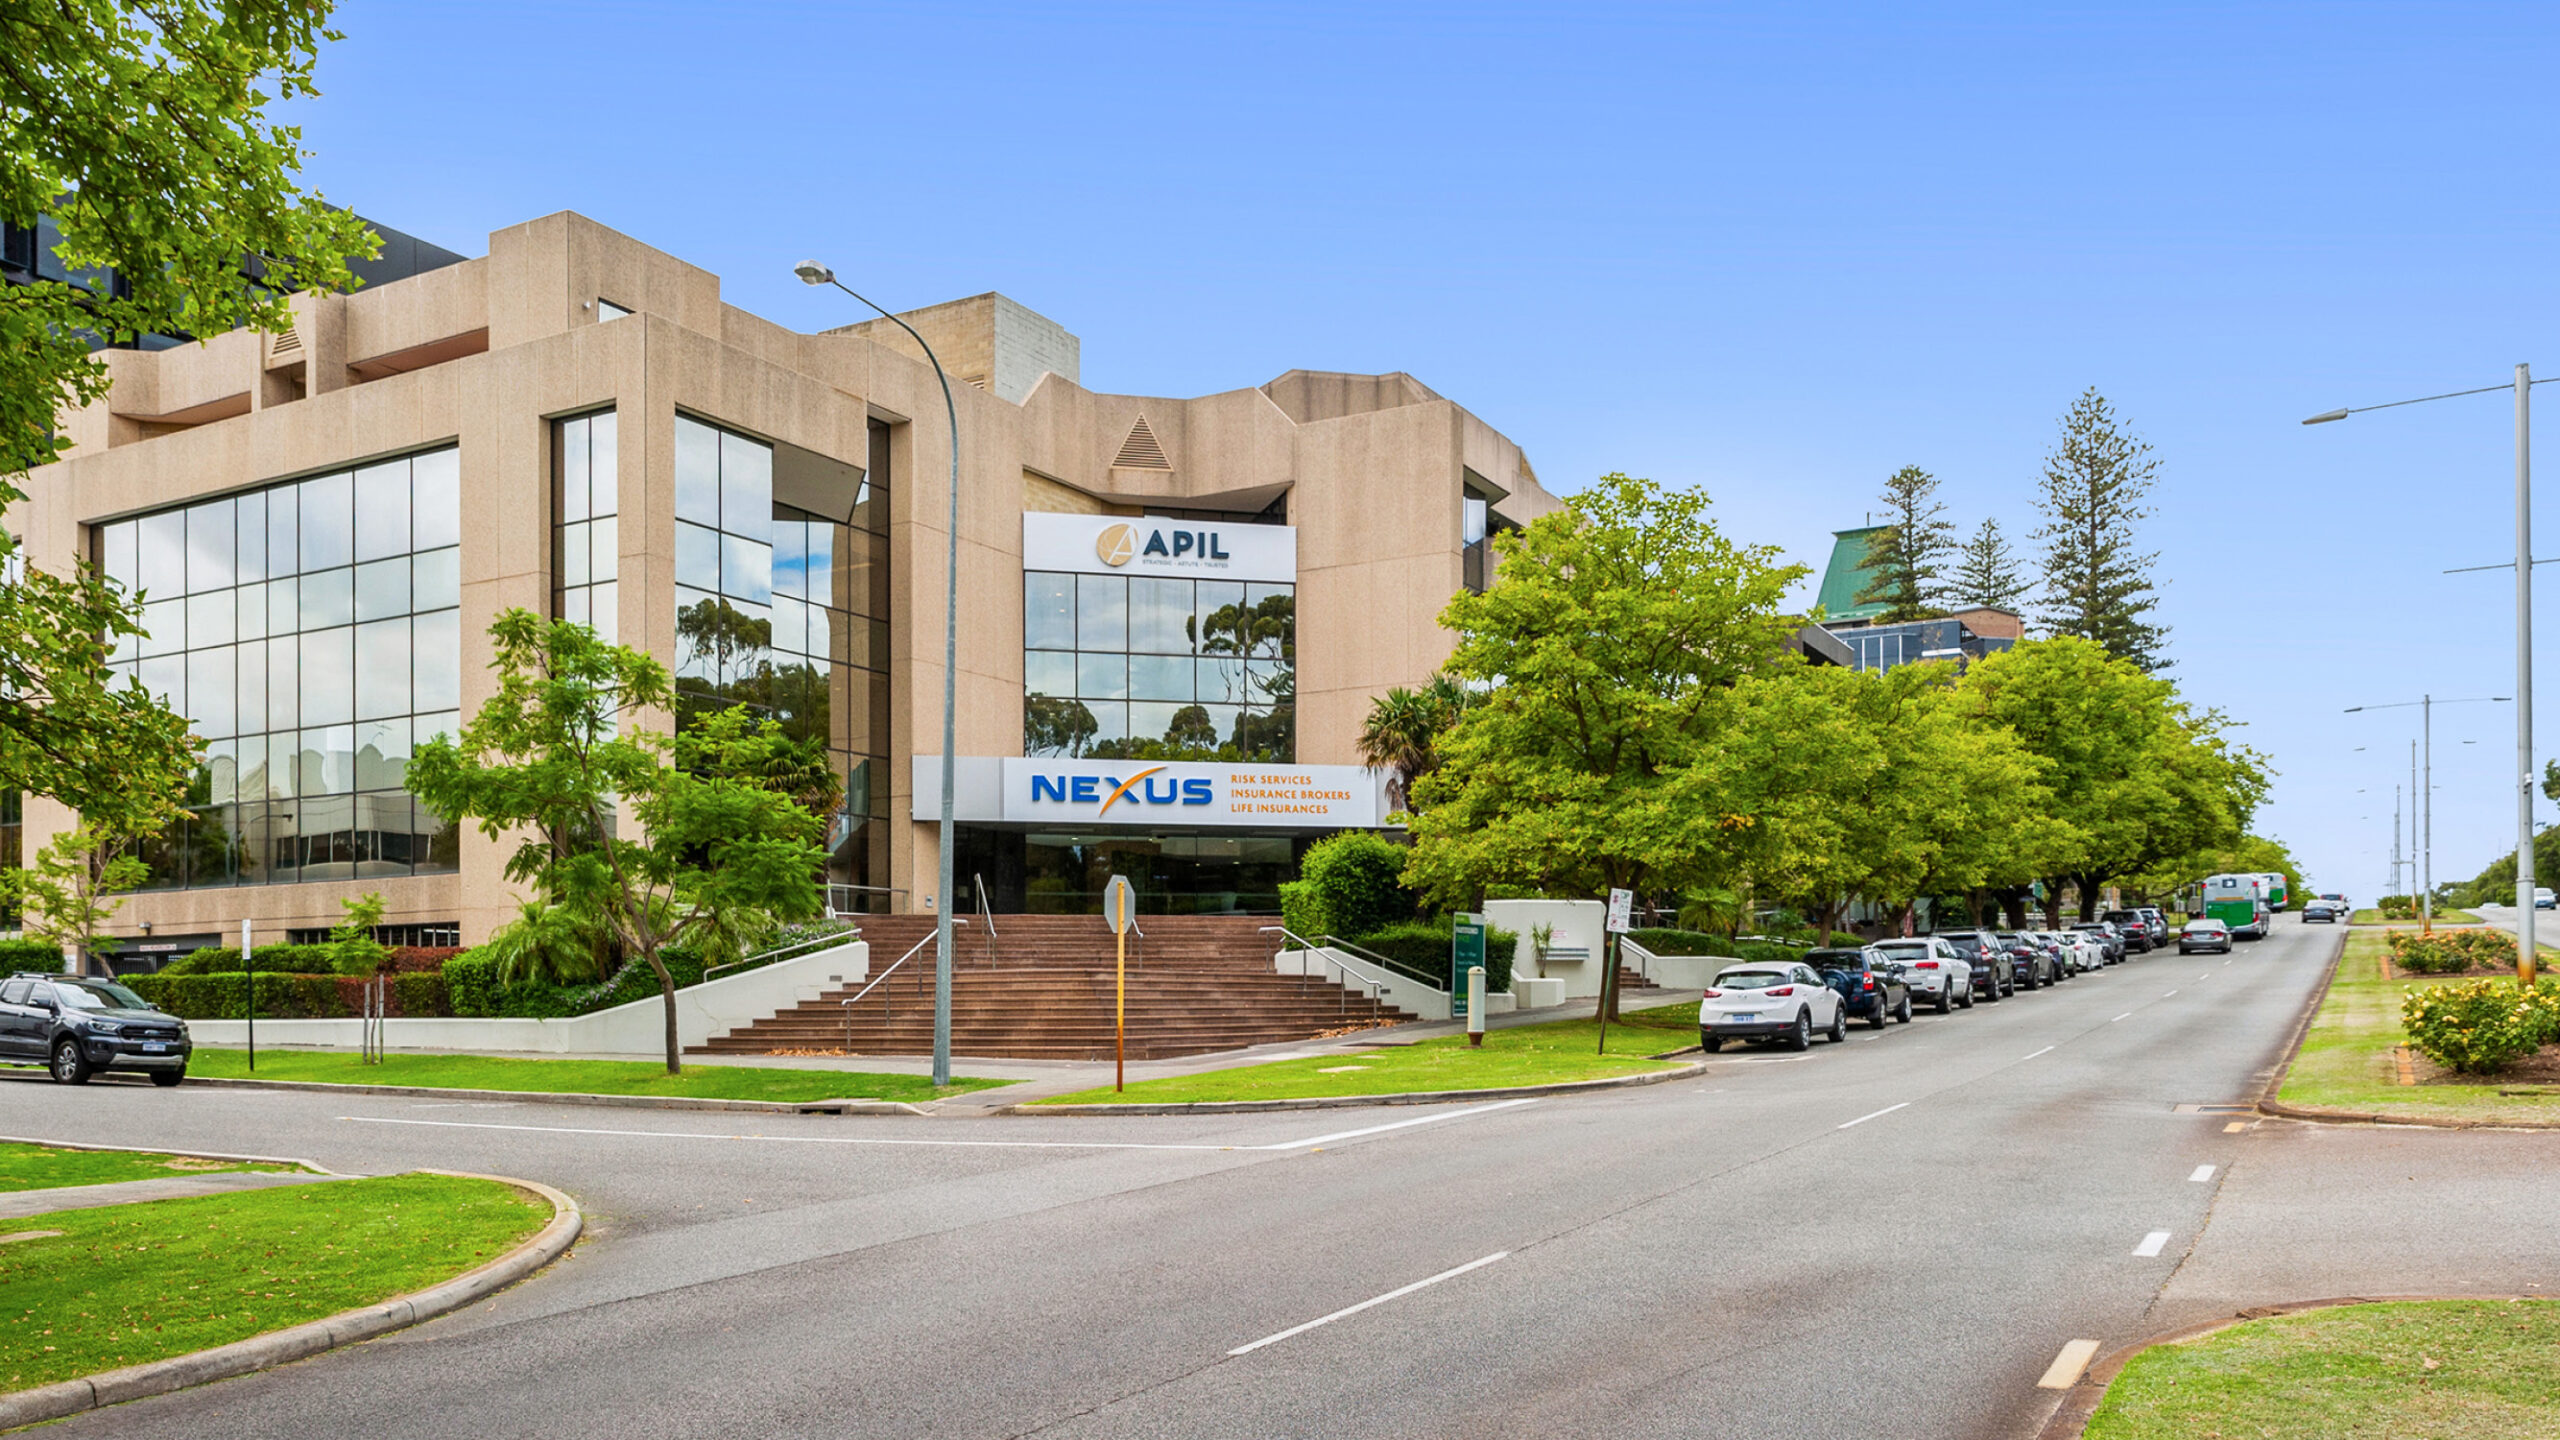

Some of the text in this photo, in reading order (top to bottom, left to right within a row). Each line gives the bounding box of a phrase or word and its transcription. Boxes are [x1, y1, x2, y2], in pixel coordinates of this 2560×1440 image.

[1143, 529, 1230, 560] APIL
[1231, 774, 1312, 785] RISK SERVICES
[1032, 766, 1213, 818] NEXUS
[1231, 789, 1351, 800] INSURANCE BROKERS
[1231, 803, 1328, 814] LIFE INSURANCES
